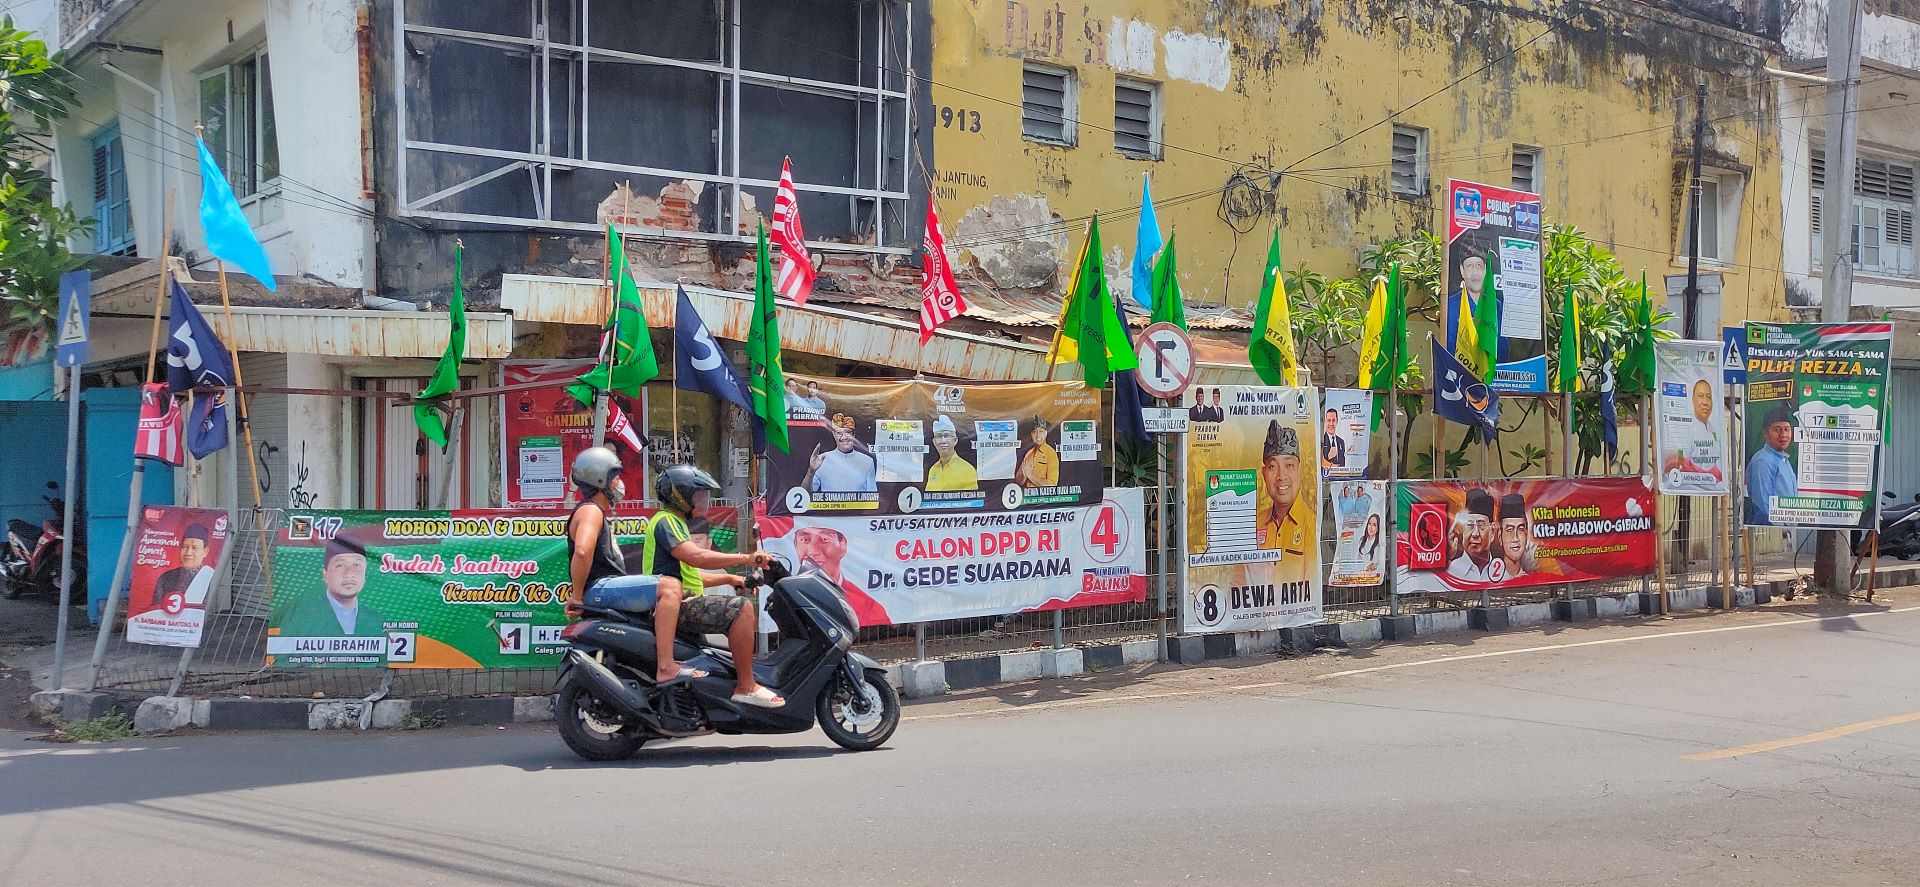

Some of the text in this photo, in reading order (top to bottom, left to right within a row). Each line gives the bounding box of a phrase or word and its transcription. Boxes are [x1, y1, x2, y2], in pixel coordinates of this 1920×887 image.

[943, 171, 988, 190] JANTUNG,
[1487, 199, 1510, 213] COBLOS
[1485, 213, 1508, 227] NOMOR
[1508, 216, 1512, 228] 2
[1504, 260, 1512, 270] 14
[1496, 278, 1502, 289] 2
[1696, 350, 1706, 362] 17
[1806, 350, 1825, 358] YUK
[1828, 350, 1884, 359] SAMA-SAMA
[1748, 359, 1796, 373] PILIH
[1800, 360, 1862, 376] REZZA
[1236, 392, 1278, 402] YANG MUDA
[792, 406, 826, 414] PRABOWO
[1229, 405, 1286, 415] YANG BERKARYA
[546, 414, 589, 426] GANJAR
[1812, 416, 1824, 426] 17
[888, 433, 894, 441] 4
[1810, 430, 1844, 441] MUHAMMAD
[1844, 432, 1861, 441] REZZA
[1862, 432, 1879, 442] YUNUS
[1674, 472, 1678, 482] 2
[793, 493, 803, 508] 2
[906, 493, 913, 508] 1
[1008, 490, 1017, 505] 8
[1780, 498, 1820, 508] MUHAMMAD
[1820, 499, 1841, 509] REZZA
[1842, 500, 1864, 510] YUNUS
[1532, 504, 1600, 520] Kita Indonesia
[316, 517, 509, 540] 17 MOHON DOA &
[870, 511, 1076, 532] SATU-SATUNYA PUTRA BULELENG
[1533, 517, 1651, 537] Kita PRABOWO-GIBRAN
[1090, 506, 1119, 556] 4
[140, 535, 180, 547] Amanah
[896, 528, 1060, 561] CALON DPD RI
[137, 555, 171, 568] Bangsa
[1221, 554, 1242, 562] KADEK
[1417, 552, 1441, 565] PROJO
[381, 554, 538, 578] Sudah Saatnya
[1492, 561, 1501, 578] 2
[868, 558, 1072, 590] Dr. GEDE SUARDANA
[444, 583, 550, 603] Kembali Ke
[167, 594, 182, 613] 3
[1203, 589, 1218, 621] 8
[1231, 584, 1275, 610] DEWA
[1281, 580, 1311, 605] ARTA
[508, 628, 522, 650] 1
[539, 630, 550, 641] H.
[296, 639, 380, 651] LALU IBRAHIM
[394, 638, 407, 656] 2
[535, 647, 554, 655] Caleg
